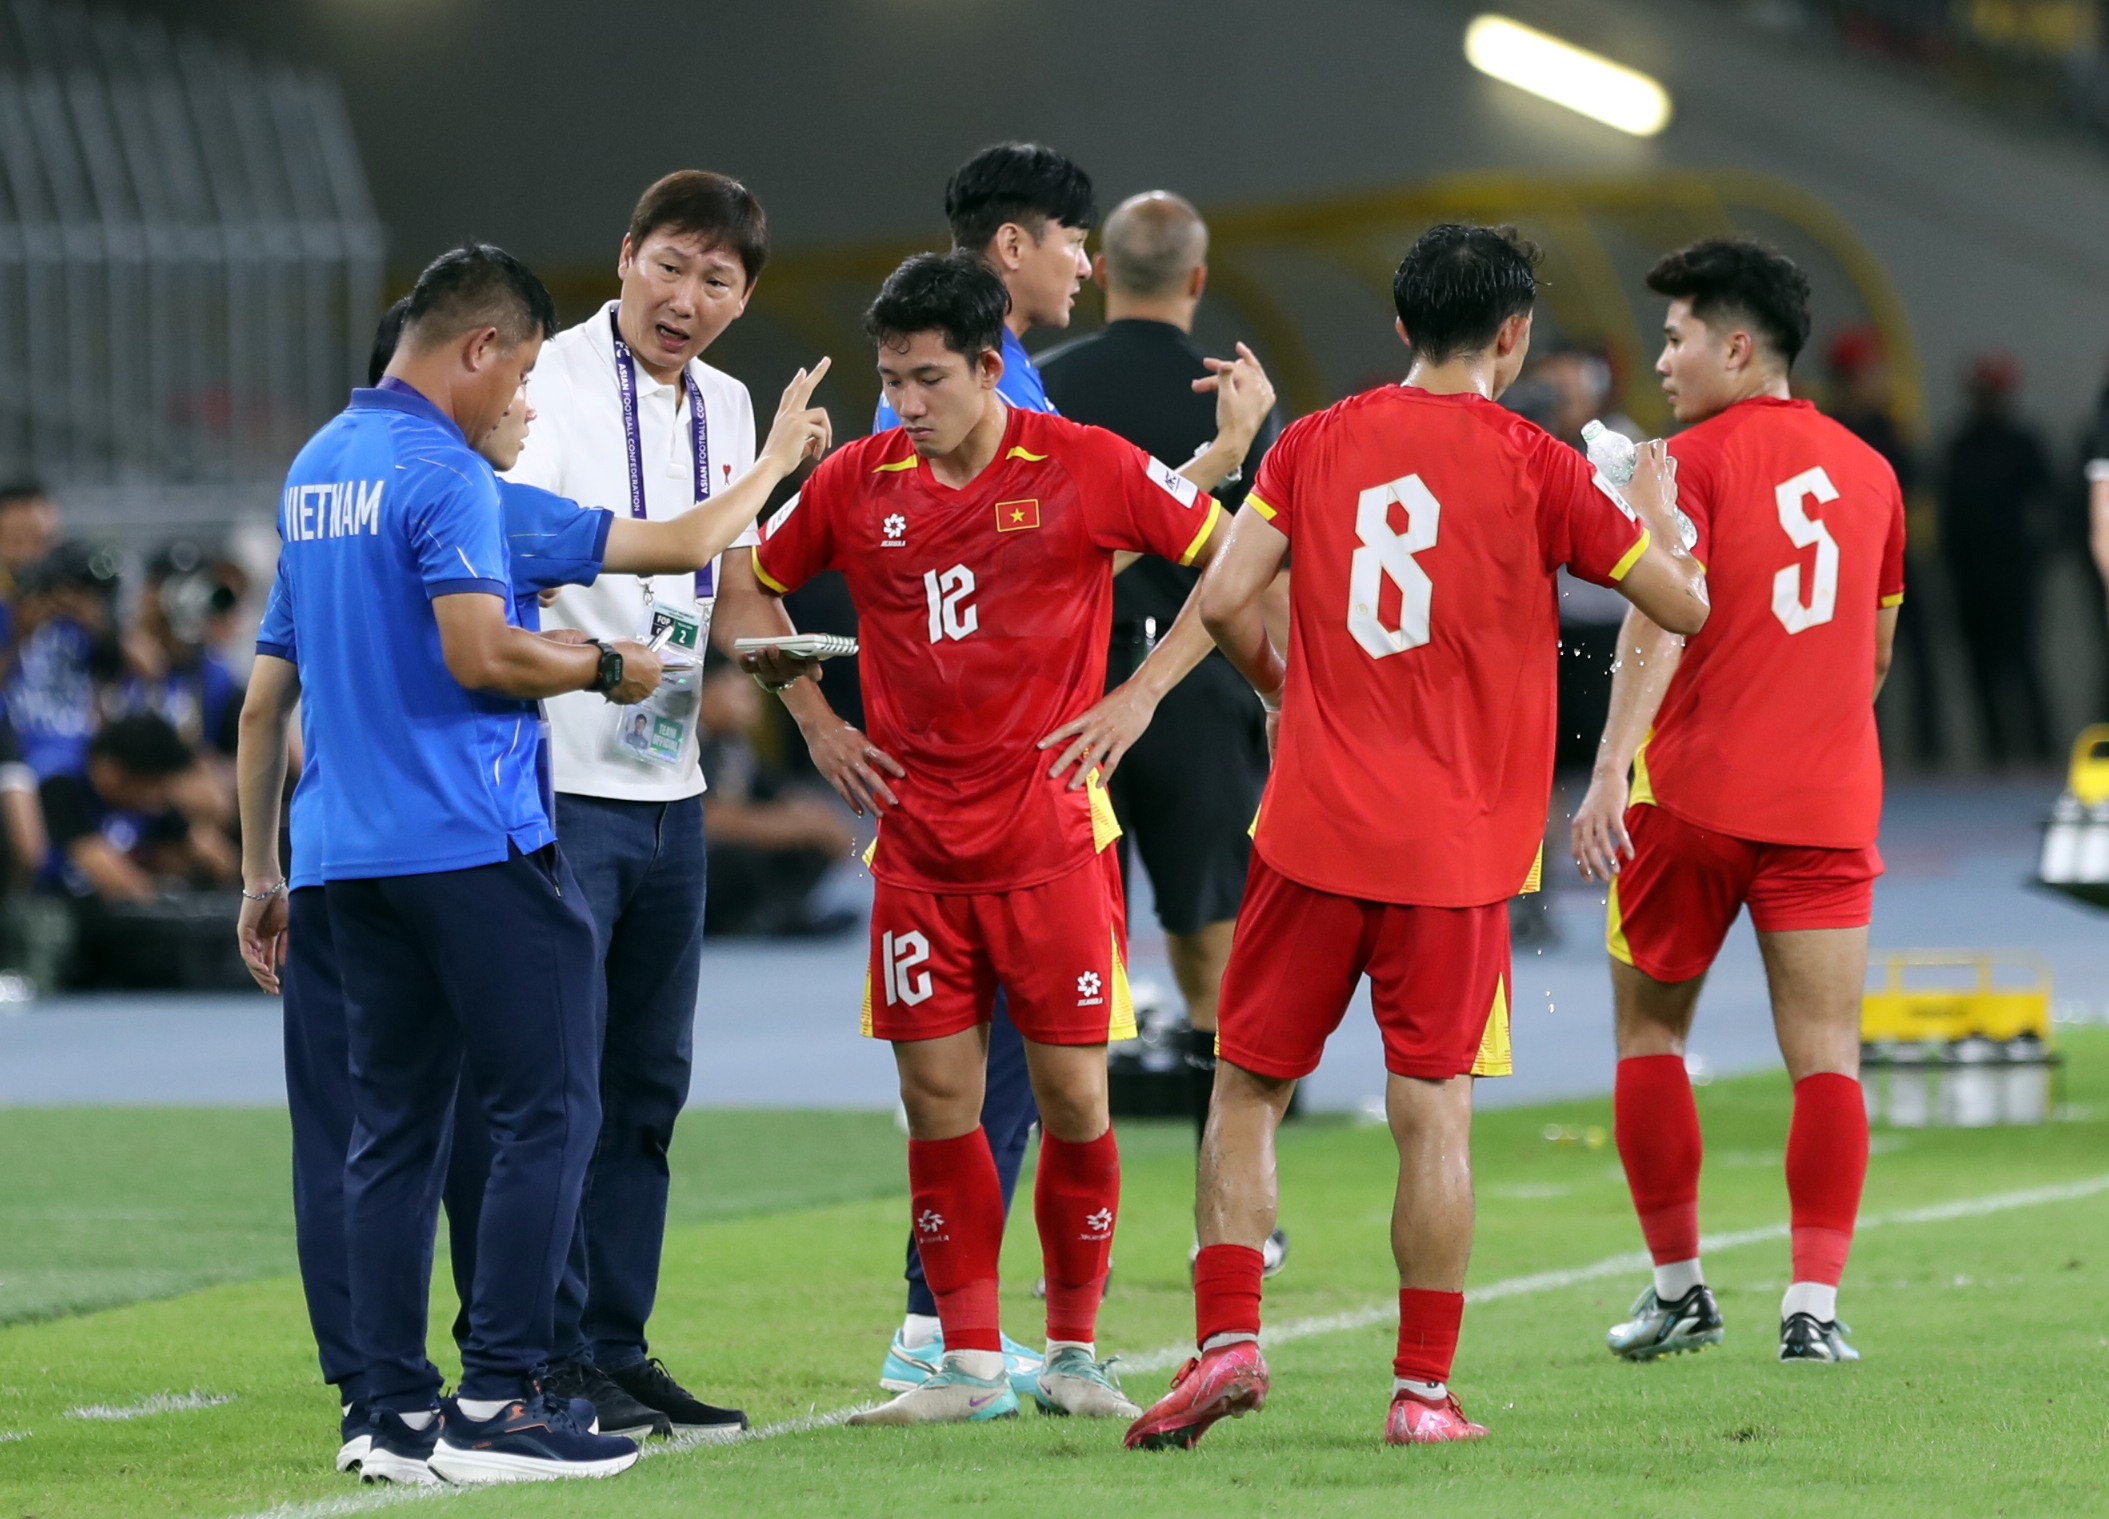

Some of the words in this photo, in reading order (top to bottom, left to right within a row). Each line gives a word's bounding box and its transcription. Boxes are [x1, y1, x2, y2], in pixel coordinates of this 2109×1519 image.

[618, 363, 630, 390] ASIAN
[623, 392, 634, 438] FOOTBALL
[698, 419, 708, 465] FOOTBALL
[627, 437, 641, 512] CONFEDERATION
[700, 466, 709, 495] ASIAN
[284, 480, 385, 543] VIETNAM
[1346, 472, 1441, 660] 8
[1770, 465, 1841, 635] 5
[656, 614, 671, 626] FOP
[923, 563, 979, 645] 12
[678, 629, 687, 644] 2
[659, 722, 677, 739] TEAM
[882, 929, 934, 1007] 12
